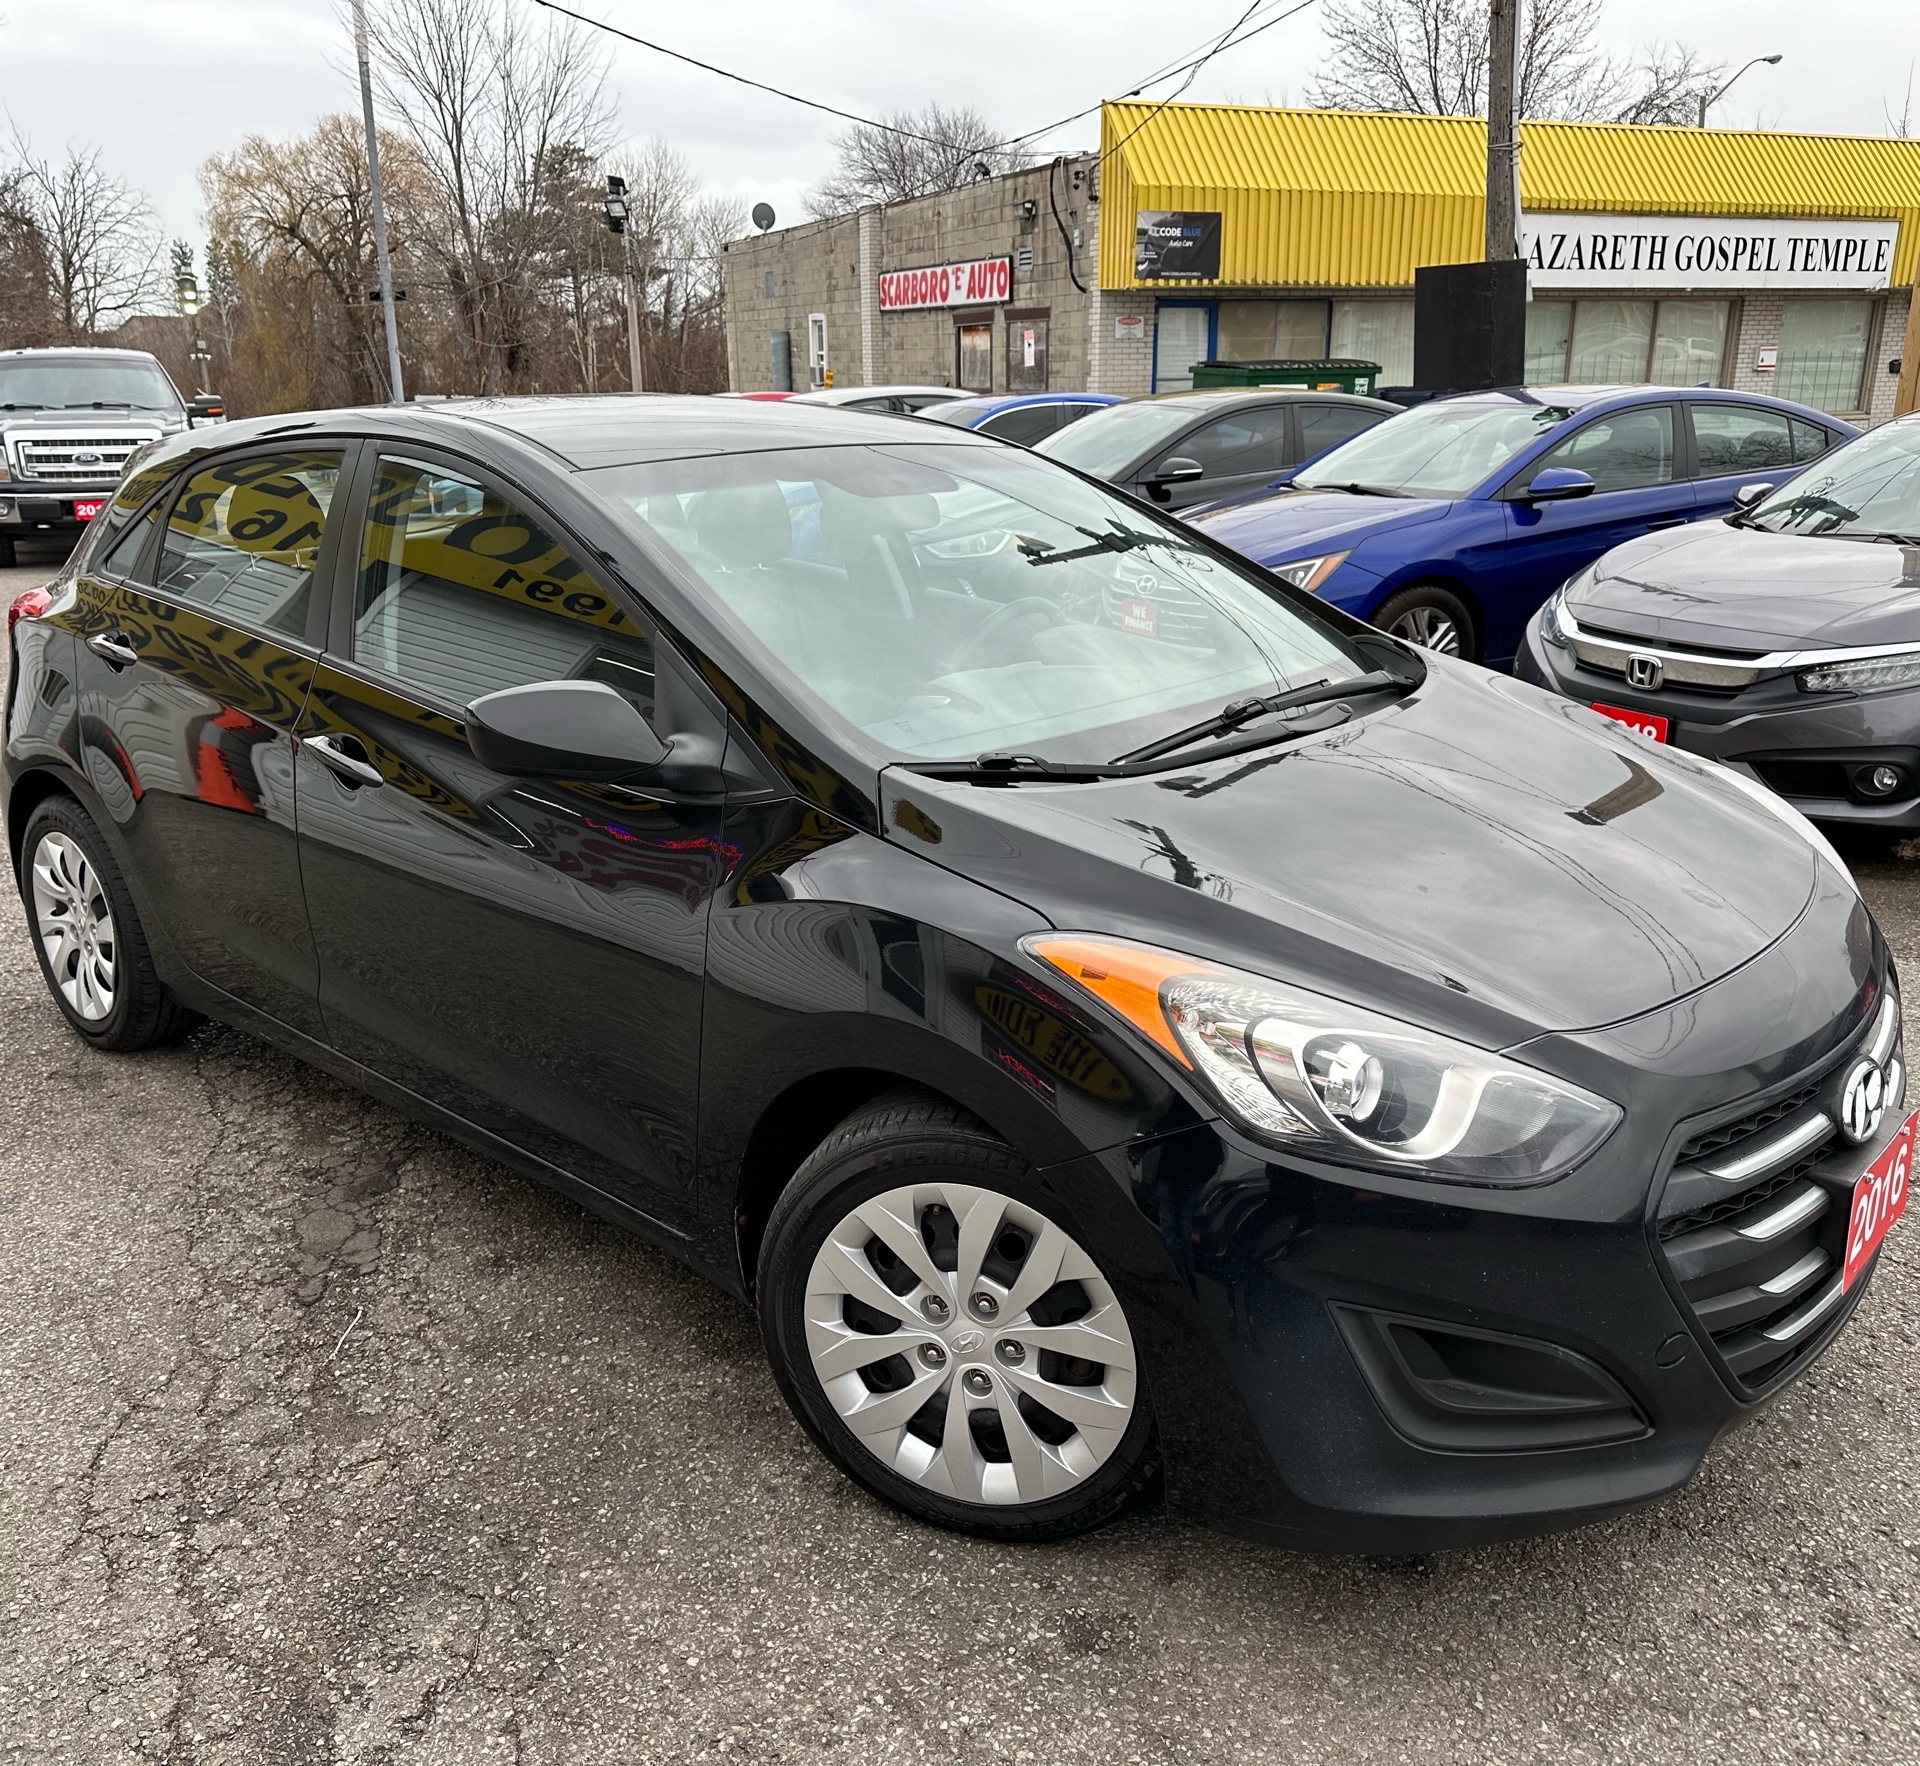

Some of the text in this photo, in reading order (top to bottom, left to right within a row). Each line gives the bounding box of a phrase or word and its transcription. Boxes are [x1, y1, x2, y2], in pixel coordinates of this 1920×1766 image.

[1160, 227, 1202, 237] CODE BLUE
[1674, 235, 1781, 271] GOSPEL
[1787, 237, 1890, 272] TEMPLE
[880, 268, 949, 307] SCARBORO
[966, 260, 1008, 300] AUTO
[77, 504, 102, 516] 20
[1132, 604, 1147, 619] WE
[1124, 615, 1153, 631] FINANCE
[1849, 1143, 1908, 1264] 2016
